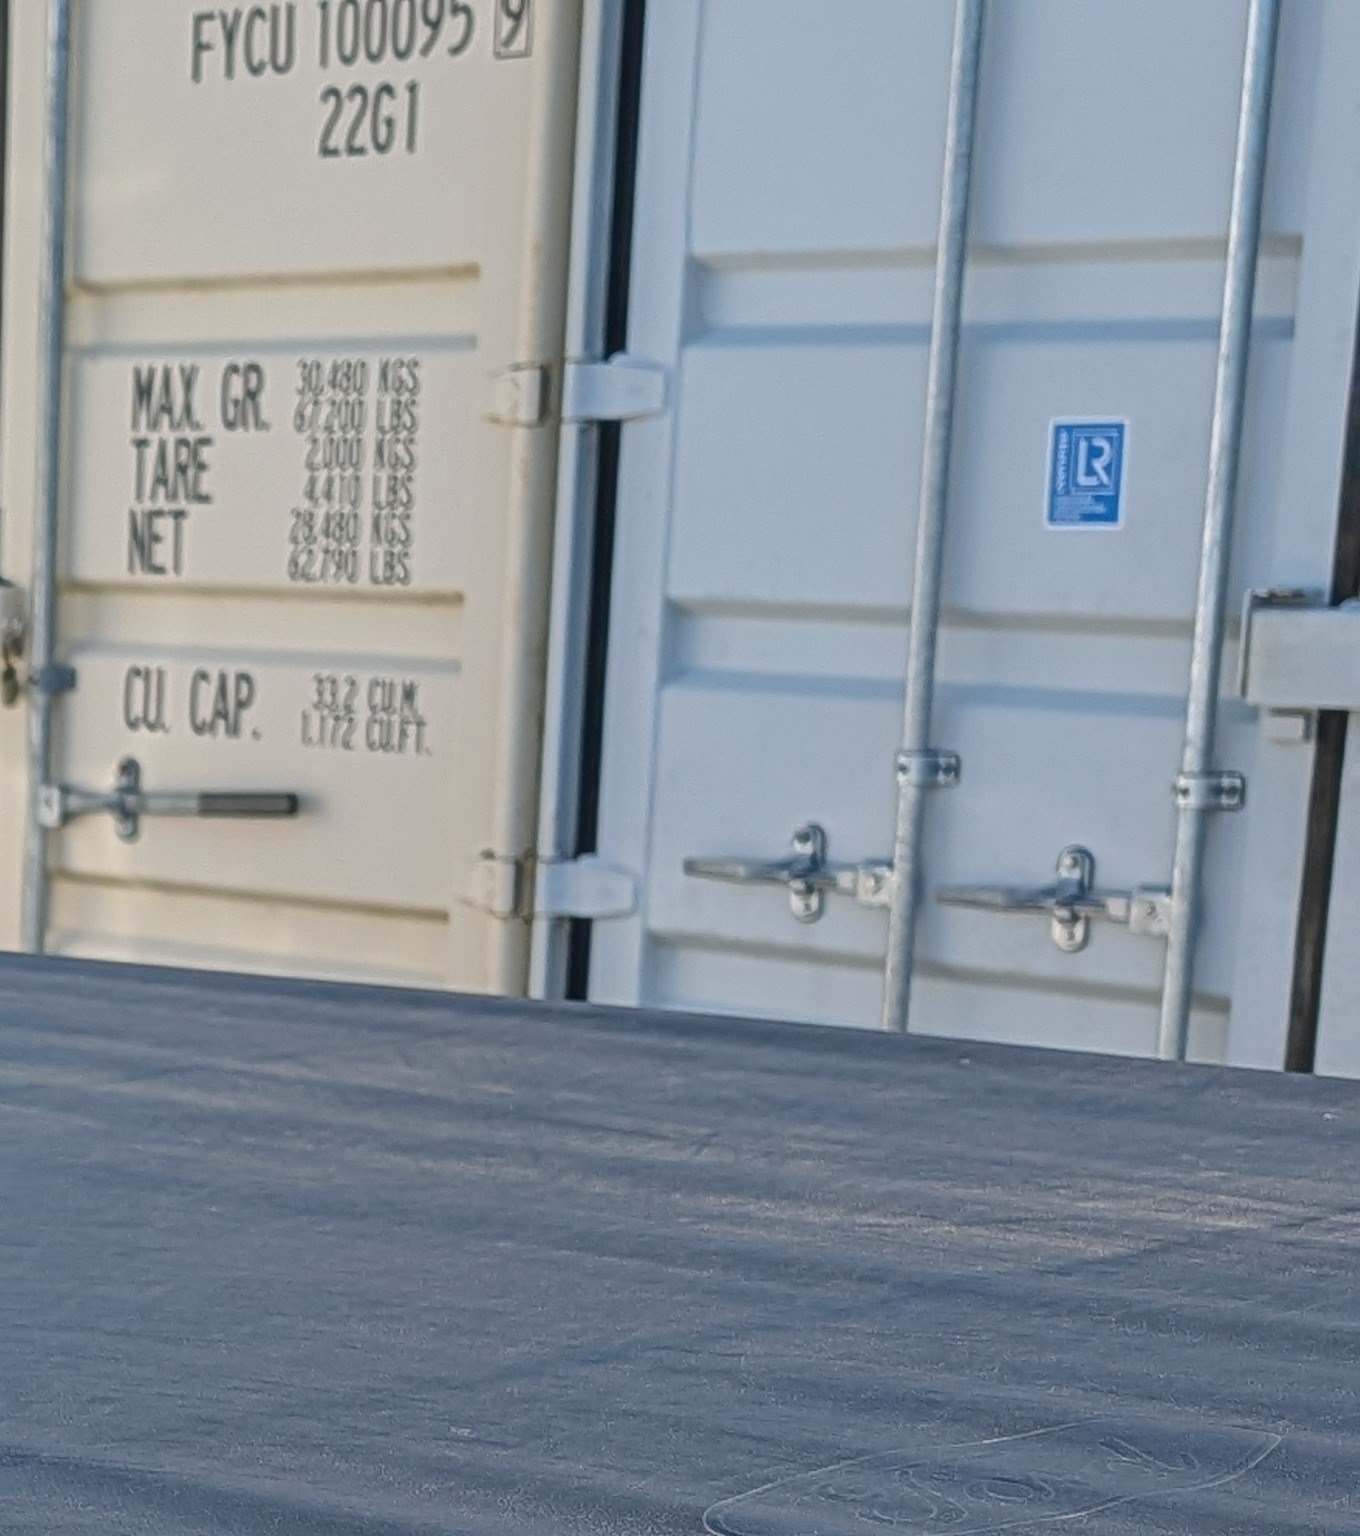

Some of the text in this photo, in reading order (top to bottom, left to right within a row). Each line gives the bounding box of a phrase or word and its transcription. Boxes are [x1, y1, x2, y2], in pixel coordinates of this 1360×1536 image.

[191, 1, 296, 84] FYCU
[320, 0, 474, 67] 100095
[319, 79, 419, 158] 22G1
[377, 359, 420, 396] KGS
[376, 399, 418, 435] LBS
[132, 437, 212, 504] TARE
[374, 438, 416, 473] KGS
[1077, 437, 1113, 488] LR
[372, 475, 413, 510] LBS
[128, 508, 188, 575] NET
[371, 512, 412, 547] KGS
[370, 549, 411, 586] LBS
[190, 667, 263, 740] CAP.
